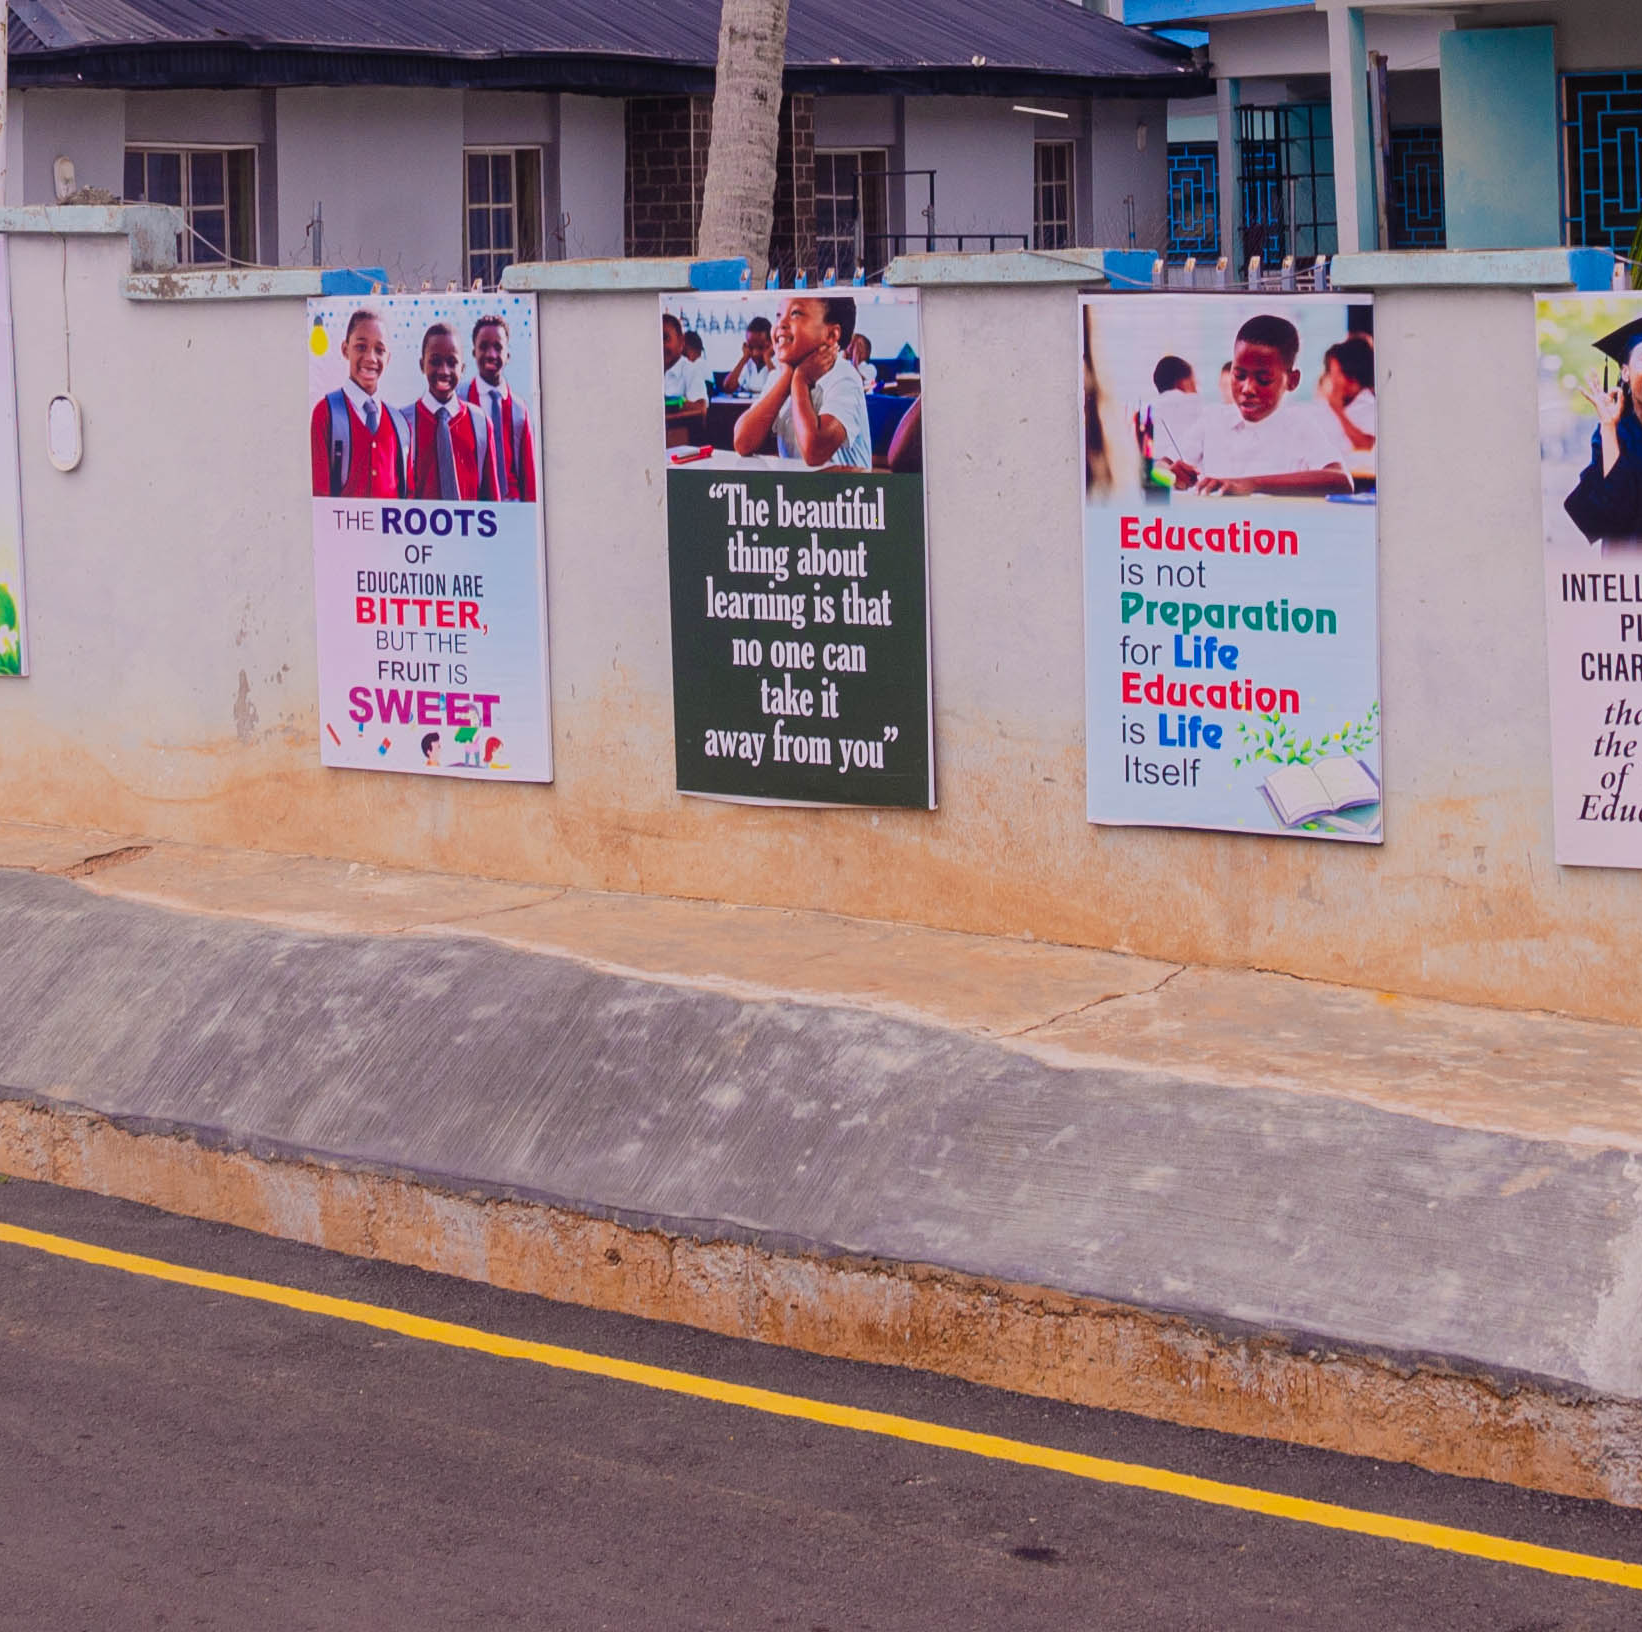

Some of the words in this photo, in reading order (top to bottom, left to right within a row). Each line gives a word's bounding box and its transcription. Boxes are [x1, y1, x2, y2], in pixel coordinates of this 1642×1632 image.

[332, 509, 375, 533] THE
[380, 506, 498, 538] ROOTS
[707, 482, 770, 529] “The
[776, 485, 886, 532] beautiful
[404, 544, 434, 565] OF
[1120, 516, 1299, 556] Education
[727, 531, 790, 582] thing
[797, 534, 868, 579] about
[1120, 556, 1144, 587] is
[1156, 560, 1207, 589] not
[356, 570, 447, 598] EDUCATION
[452, 574, 484, 599] ARE
[705, 576, 806, 630] learning
[813, 582, 837, 624] is
[842, 588, 892, 627] that
[355, 595, 489, 635] BITTER,
[1120, 591, 1338, 636] Preparation
[376, 631, 419, 653] BUT
[426, 633, 469, 655] THE
[732, 636, 763, 667] no
[770, 639, 816, 670] one
[822, 642, 867, 673] can
[1119, 635, 1162, 666] for
[1173, 635, 1240, 672] Life
[377, 660, 441, 684] FRUIT
[447, 664, 469, 685] IS
[348, 686, 501, 729] SWEET
[760, 672, 814, 718] take
[821, 676, 840, 719] it
[1121, 672, 1300, 715] Education
[704, 727, 766, 767] away
[773, 720, 832, 767] from
[838, 725, 900, 774] you”
[1122, 714, 1145, 744] is
[1158, 713, 1224, 751] Life
[1594, 731, 1638, 759] the
[1123, 754, 1202, 788] Itself
[1600, 763, 1633, 800] of
